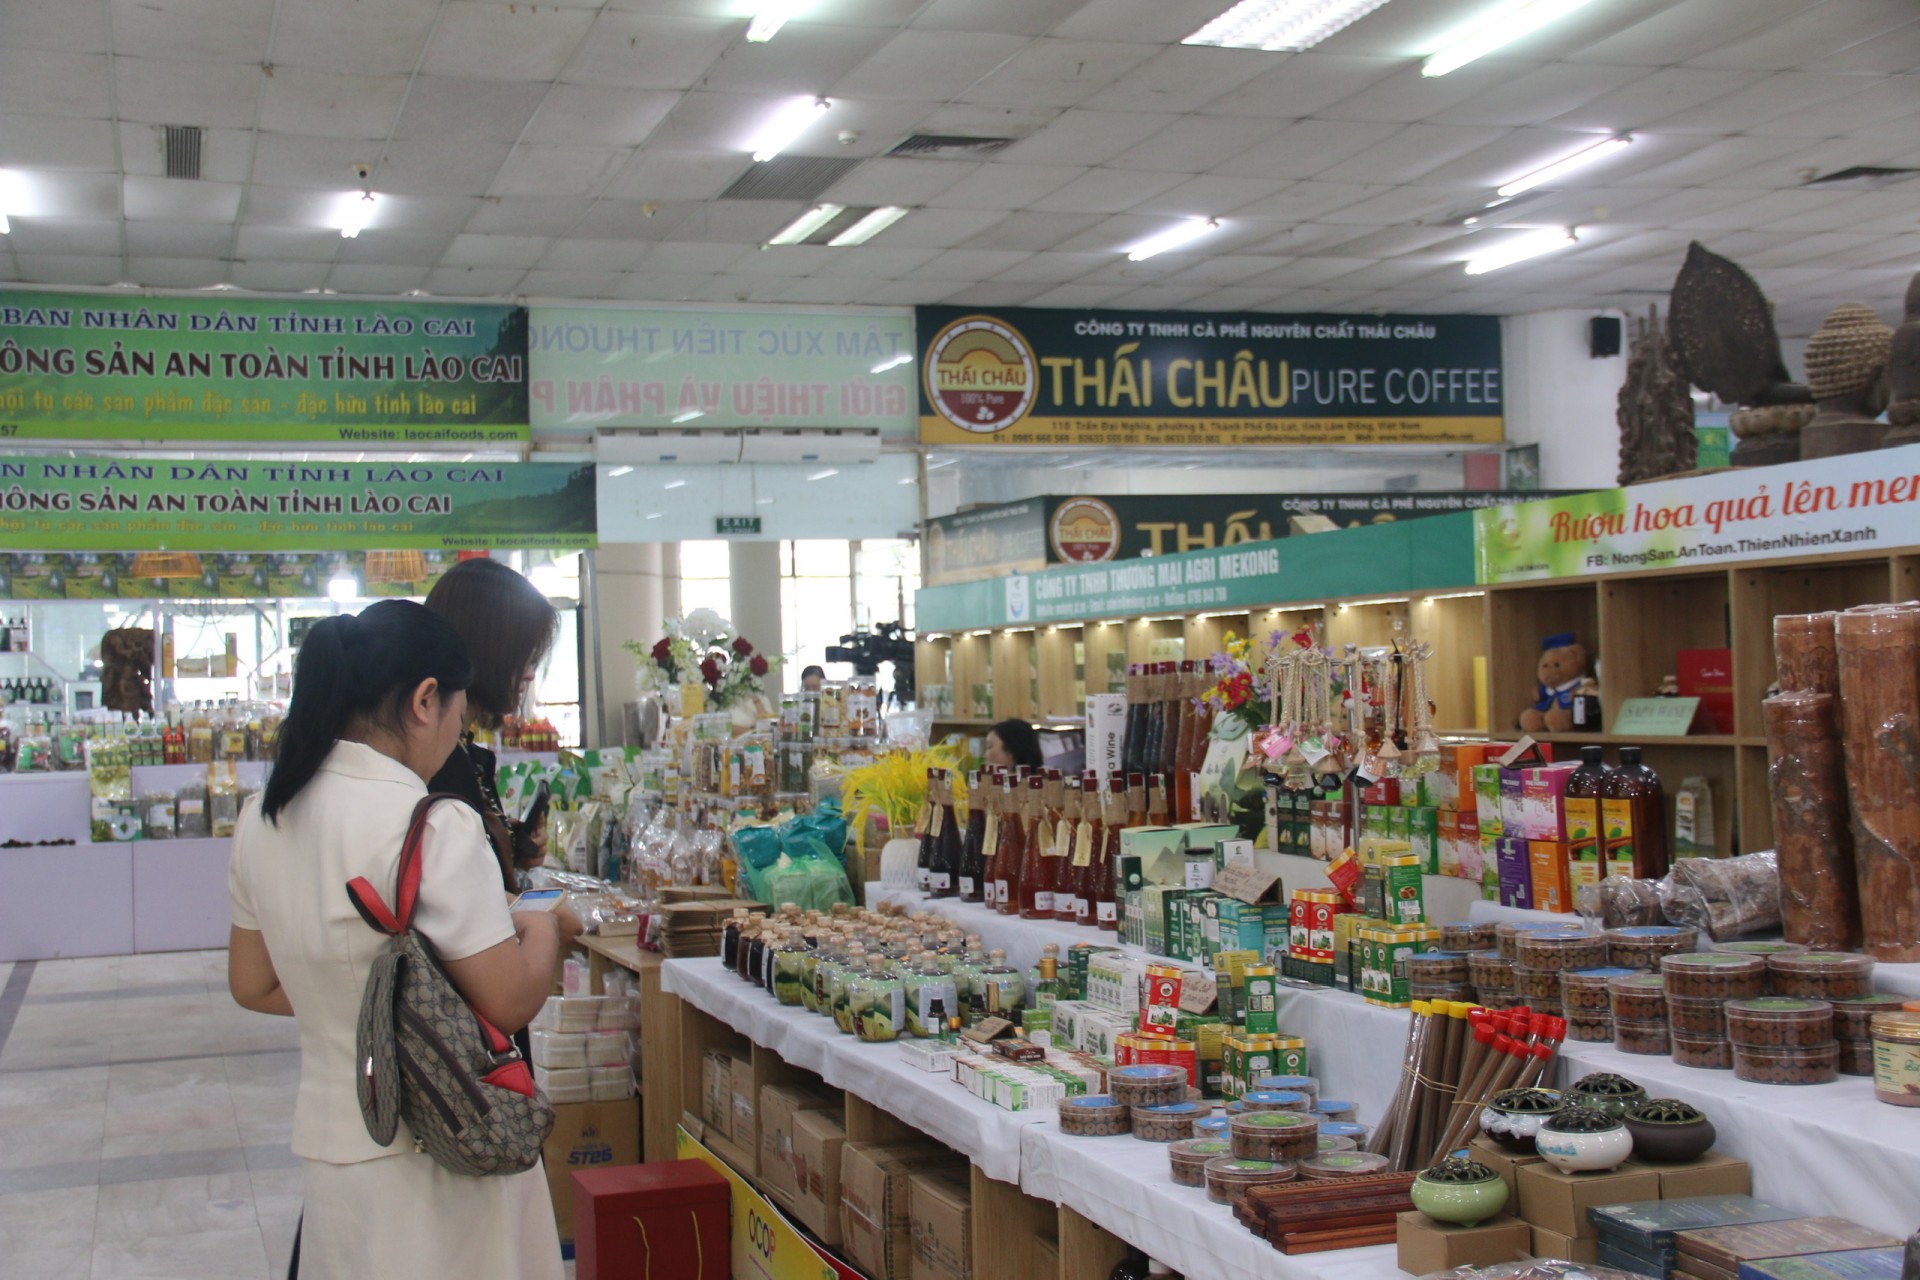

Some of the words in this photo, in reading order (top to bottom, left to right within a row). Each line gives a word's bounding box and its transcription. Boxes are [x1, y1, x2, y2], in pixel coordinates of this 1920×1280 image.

[3, 308, 70, 326] BAN
[84, 308, 177, 329] NHÂN
[191, 312, 256, 331] DÂN
[268, 312, 342, 333] TỈNH
[356, 314, 412, 335] LÀO
[424, 320, 474, 335] CAI
[1075, 319, 1124, 336] CÔNG
[1127, 323, 1144, 335] TY
[1149, 323, 1188, 336] TNHH
[1192, 321, 1215, 337] CÀ
[1220, 321, 1248, 338] PHÊ
[1251, 322, 1311, 338] NGUYÊN
[1315, 320, 1354, 339] CHẤT
[1358, 321, 1390, 339] THÁI
[1393, 321, 1436, 339] CHÂU
[86, 341, 154, 375] SẢN
[165, 352, 211, 377] AN
[220, 346, 308, 378] TOÀN
[318, 347, 394, 379] TỈNH
[405, 349, 463, 380] LÀO
[471, 356, 522, 382] CAI
[1041, 342, 1152, 407] THÁI
[1167, 350, 1289, 408] CHÂU
[1292, 369, 1377, 404] PURE
[1385, 368, 1499, 404] COFFEE
[938, 366, 977, 386] THÁI
[982, 366, 1026, 386] CHÂU
[63, 390, 94, 411] các
[103, 390, 134, 411] sản
[144, 387, 193, 417] phẩm
[452, 393, 477, 415] cai
[339, 428, 400, 440] Website:
[405, 428, 518, 440] laocaifoods.com
[43, 462, 153, 479] NHÂN
[170, 463, 248, 480] DÂN
[262, 464, 350, 482] TỈNH
[366, 465, 433, 482] LÀO
[447, 469, 504, 482] CAI
[79, 486, 138, 512] SẢN
[146, 494, 186, 512] AN
[194, 489, 269, 513] TOÀN
[276, 489, 342, 513] TỈNH
[351, 490, 401, 513] LÀO
[408, 496, 451, 513] CAI
[1323, 499, 1336, 510] TY
[1339, 499, 1369, 510] TNHH
[1372, 497, 1390, 511] CÀ
[1392, 496, 1414, 510] PHÊ
[1416, 496, 1462, 509] NGUYÊN
[1550, 511, 1627, 543] Rượu
[1633, 503, 1696, 532] hoa
[1704, 484, 1774, 534] quả
[1782, 480, 1841, 516] lên
[722, 517, 756, 528] EXIT
[443, 537, 492, 546] Website:
[495, 537, 590, 547] laocaifoods.com
[1036, 573, 1063, 600] CÔNG
[1065, 577, 1077, 597] TY
[1080, 572, 1108, 595] TNHH
[1186, 556, 1215, 584] AGRI
[1220, 549, 1279, 580] MEKONG
[1586, 555, 1609, 567] FB:
[1106, 732, 1115, 759] Wine
[749, 1208, 776, 1262] OCOP
